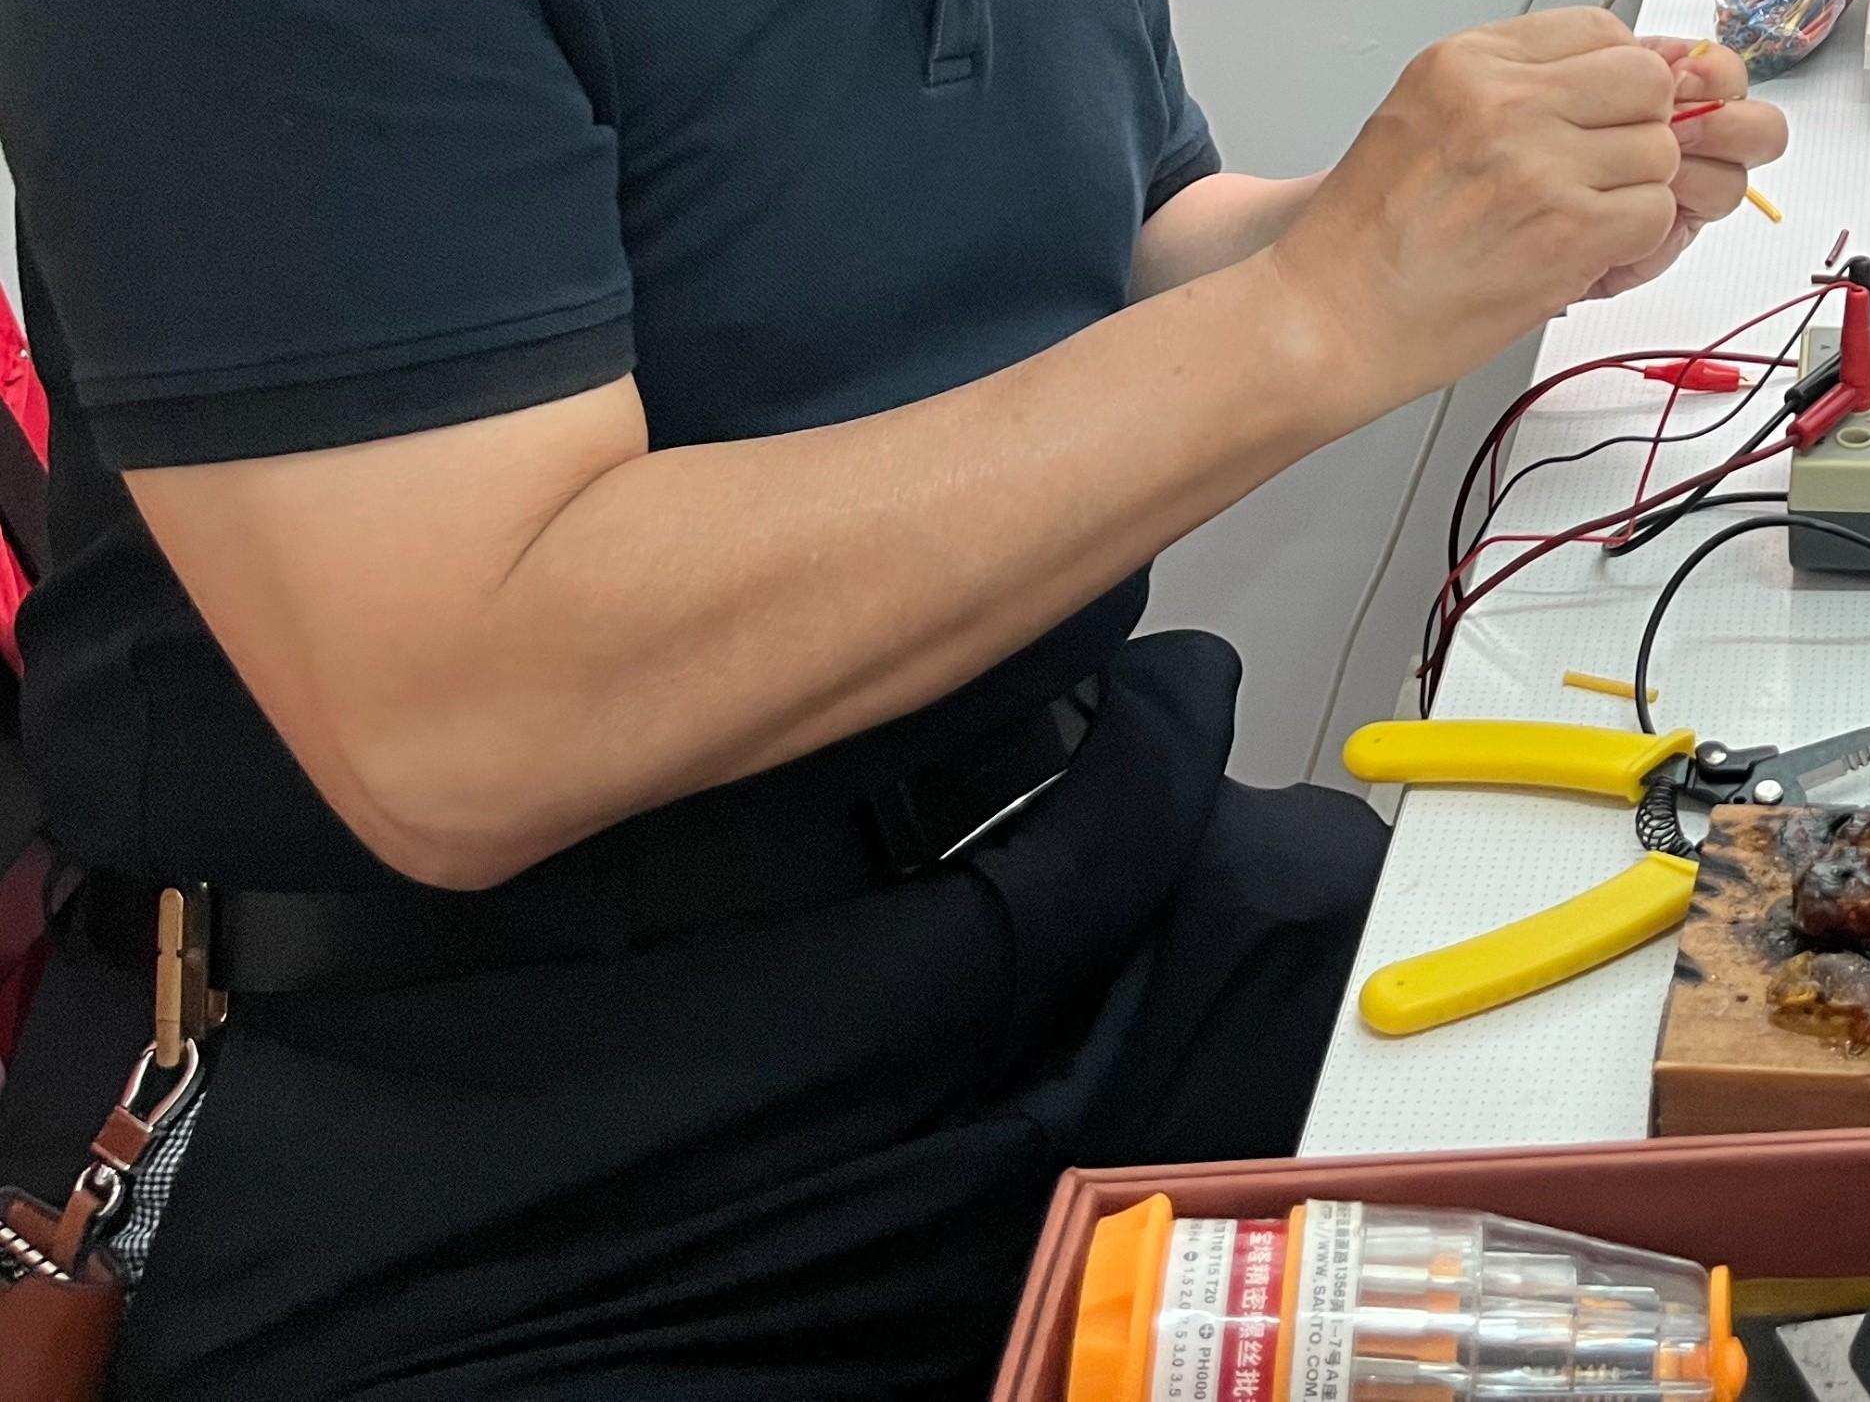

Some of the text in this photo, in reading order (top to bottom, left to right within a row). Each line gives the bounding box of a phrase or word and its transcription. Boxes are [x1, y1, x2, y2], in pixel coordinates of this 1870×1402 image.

[1233, 1230, 1275, 1402] 宝塔精密螺丝批
